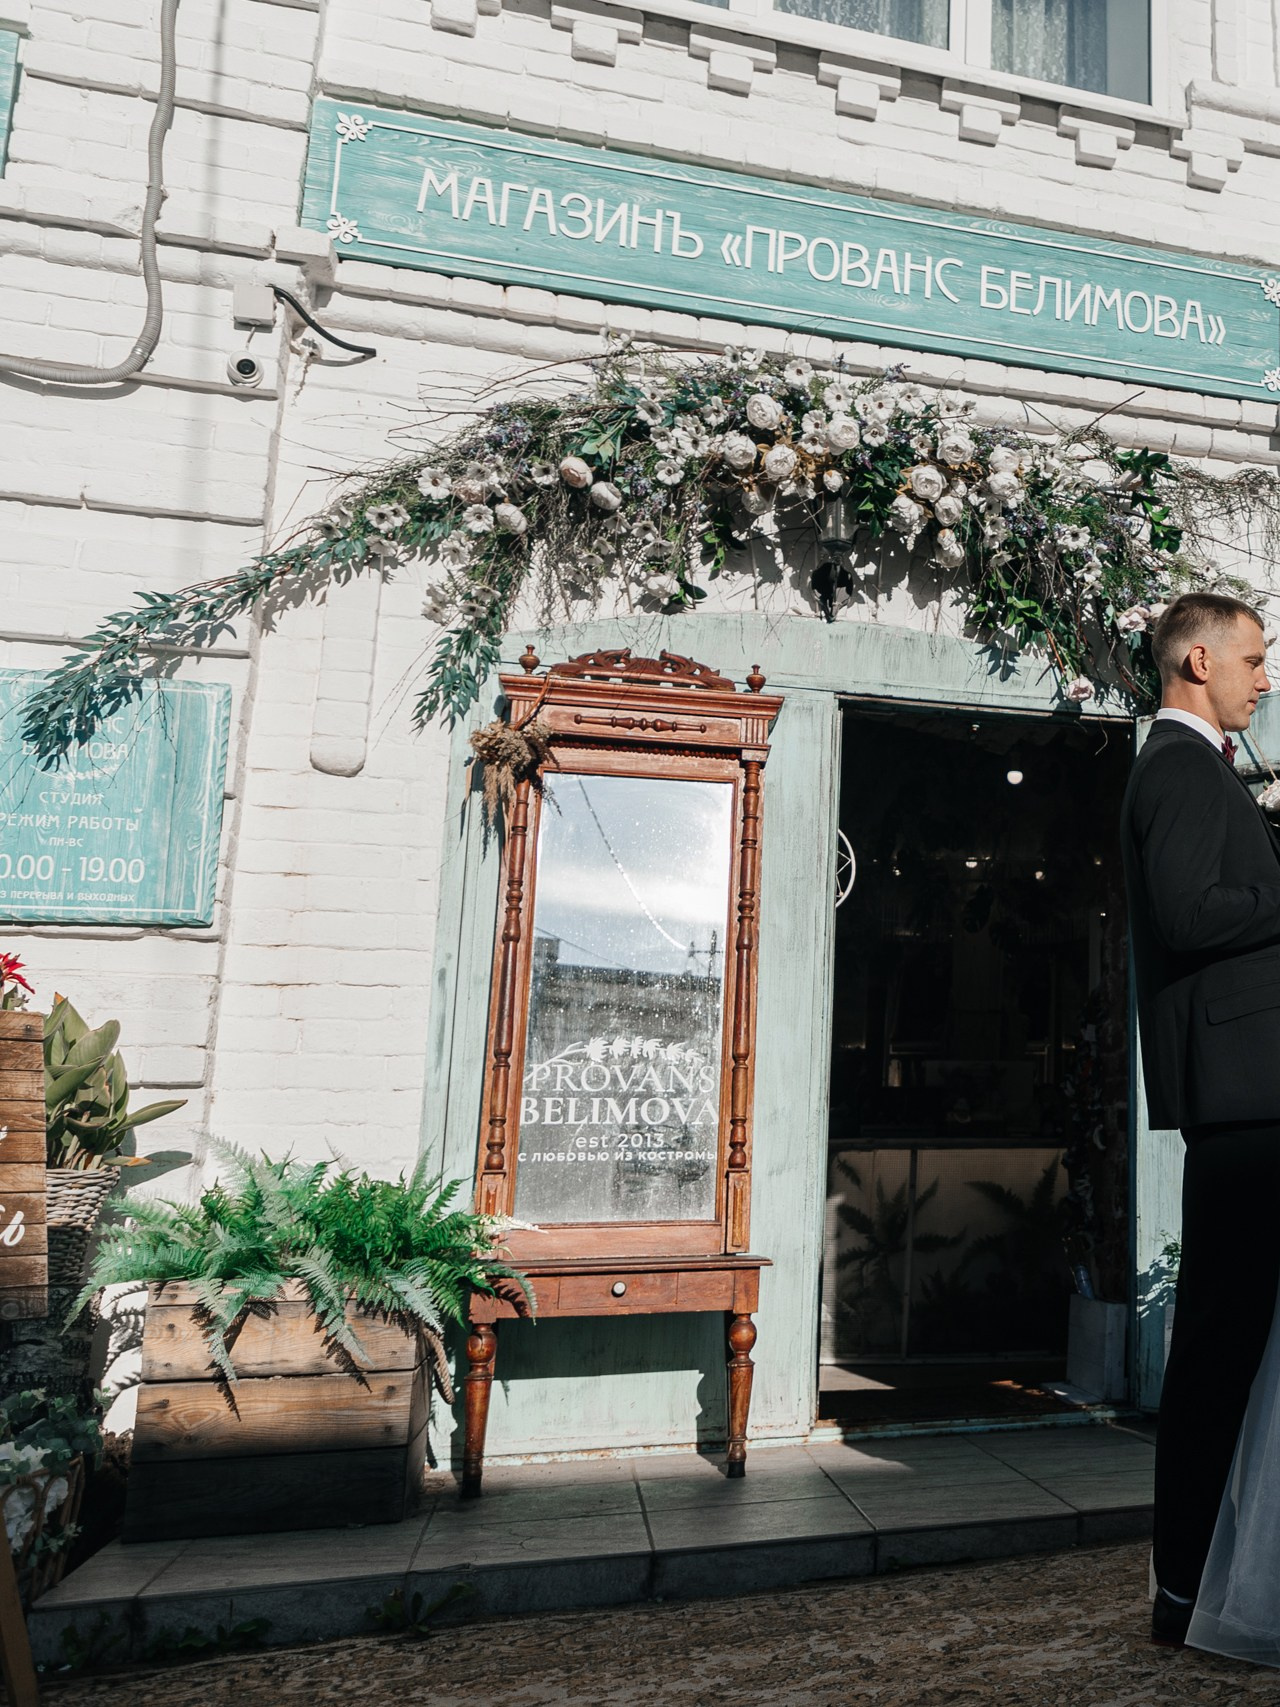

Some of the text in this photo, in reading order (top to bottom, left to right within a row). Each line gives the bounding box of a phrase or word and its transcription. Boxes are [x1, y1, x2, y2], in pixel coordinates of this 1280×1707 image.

[416, 167, 1227, 346] МАГАЗИНЪ «ПРОВАНС БЕЛИМОВА»
[39, 791, 104, 805] СТУДИЯ
[67, 815, 139, 831] РАБОТЫ
[79, 856, 145, 883] 19.00
[529, 1063, 716, 1093] PROVANS
[520, 1097, 720, 1126] BELIMOVA
[575, 1133, 665, 1149] est 2013
